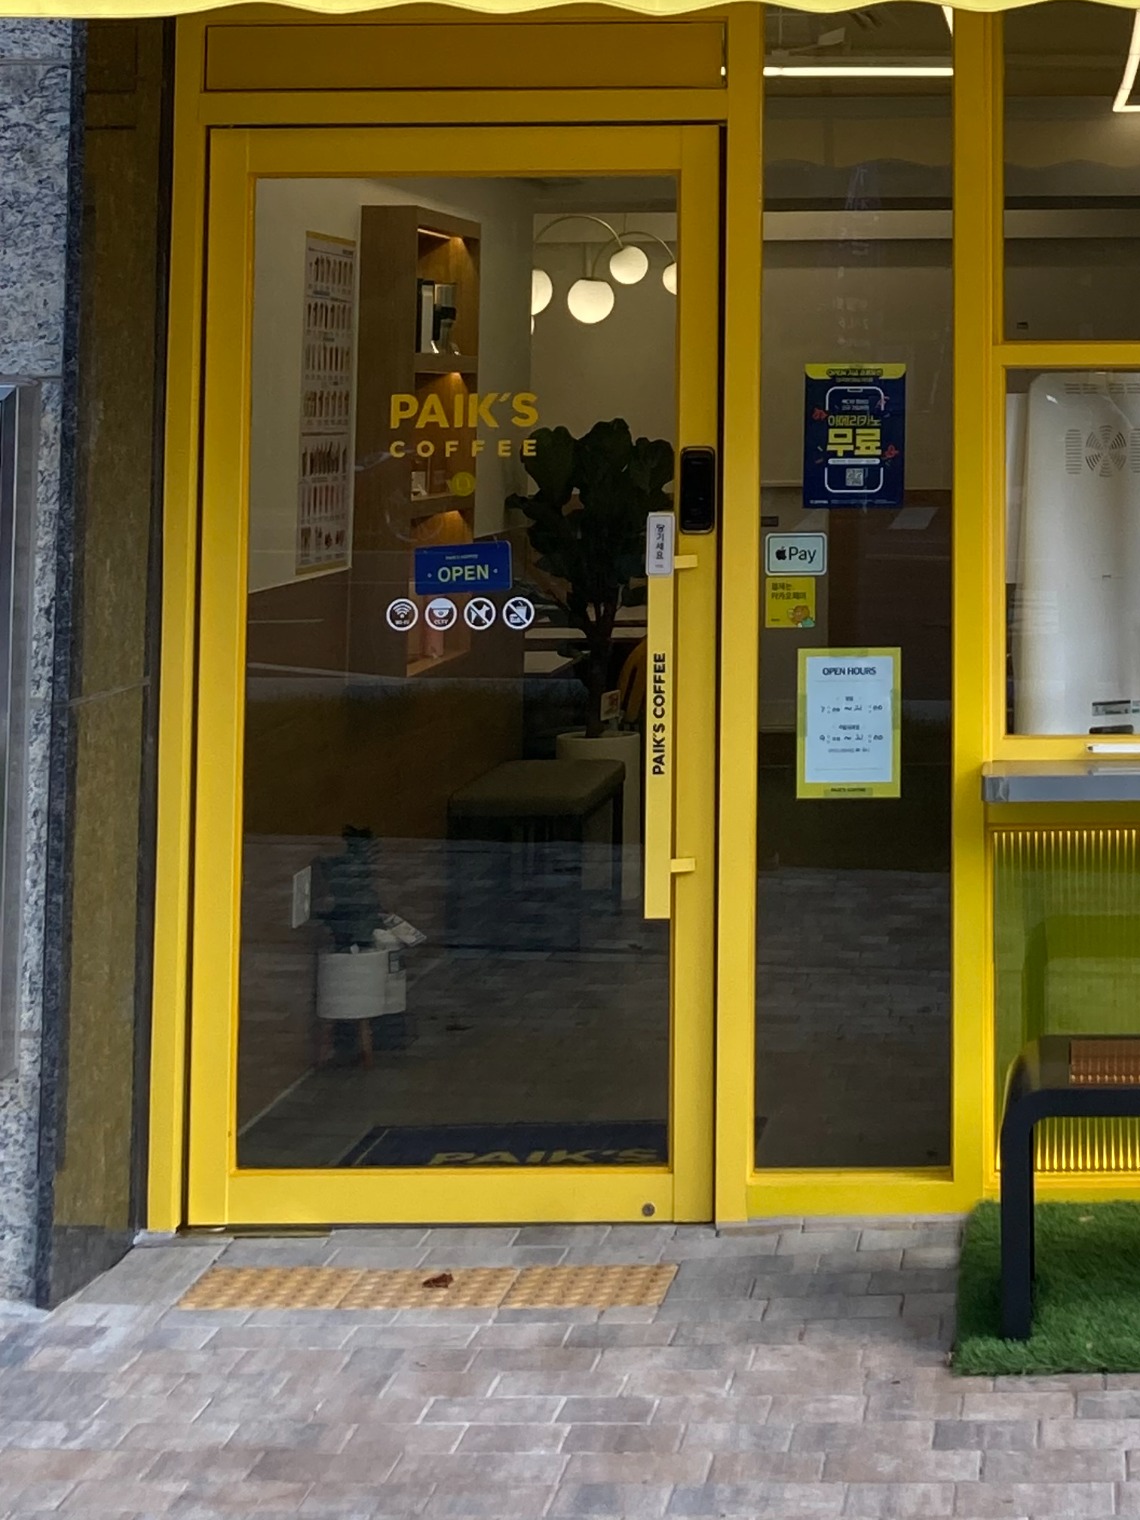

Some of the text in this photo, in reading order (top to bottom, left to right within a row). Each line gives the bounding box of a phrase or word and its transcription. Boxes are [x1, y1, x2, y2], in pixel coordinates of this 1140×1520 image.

[389, 392, 539, 429] PAIK'S
[389, 439, 538, 459] COFFEE
[826, 428, 882, 457] 무료
[656, 524, 665, 560] 당기세요
[788, 546, 817, 564] Pay
[437, 564, 489, 583] OPEN
[822, 666, 877, 676] OPEN HOURS
[652, 653, 666, 775] PAIK'S COFFEE
